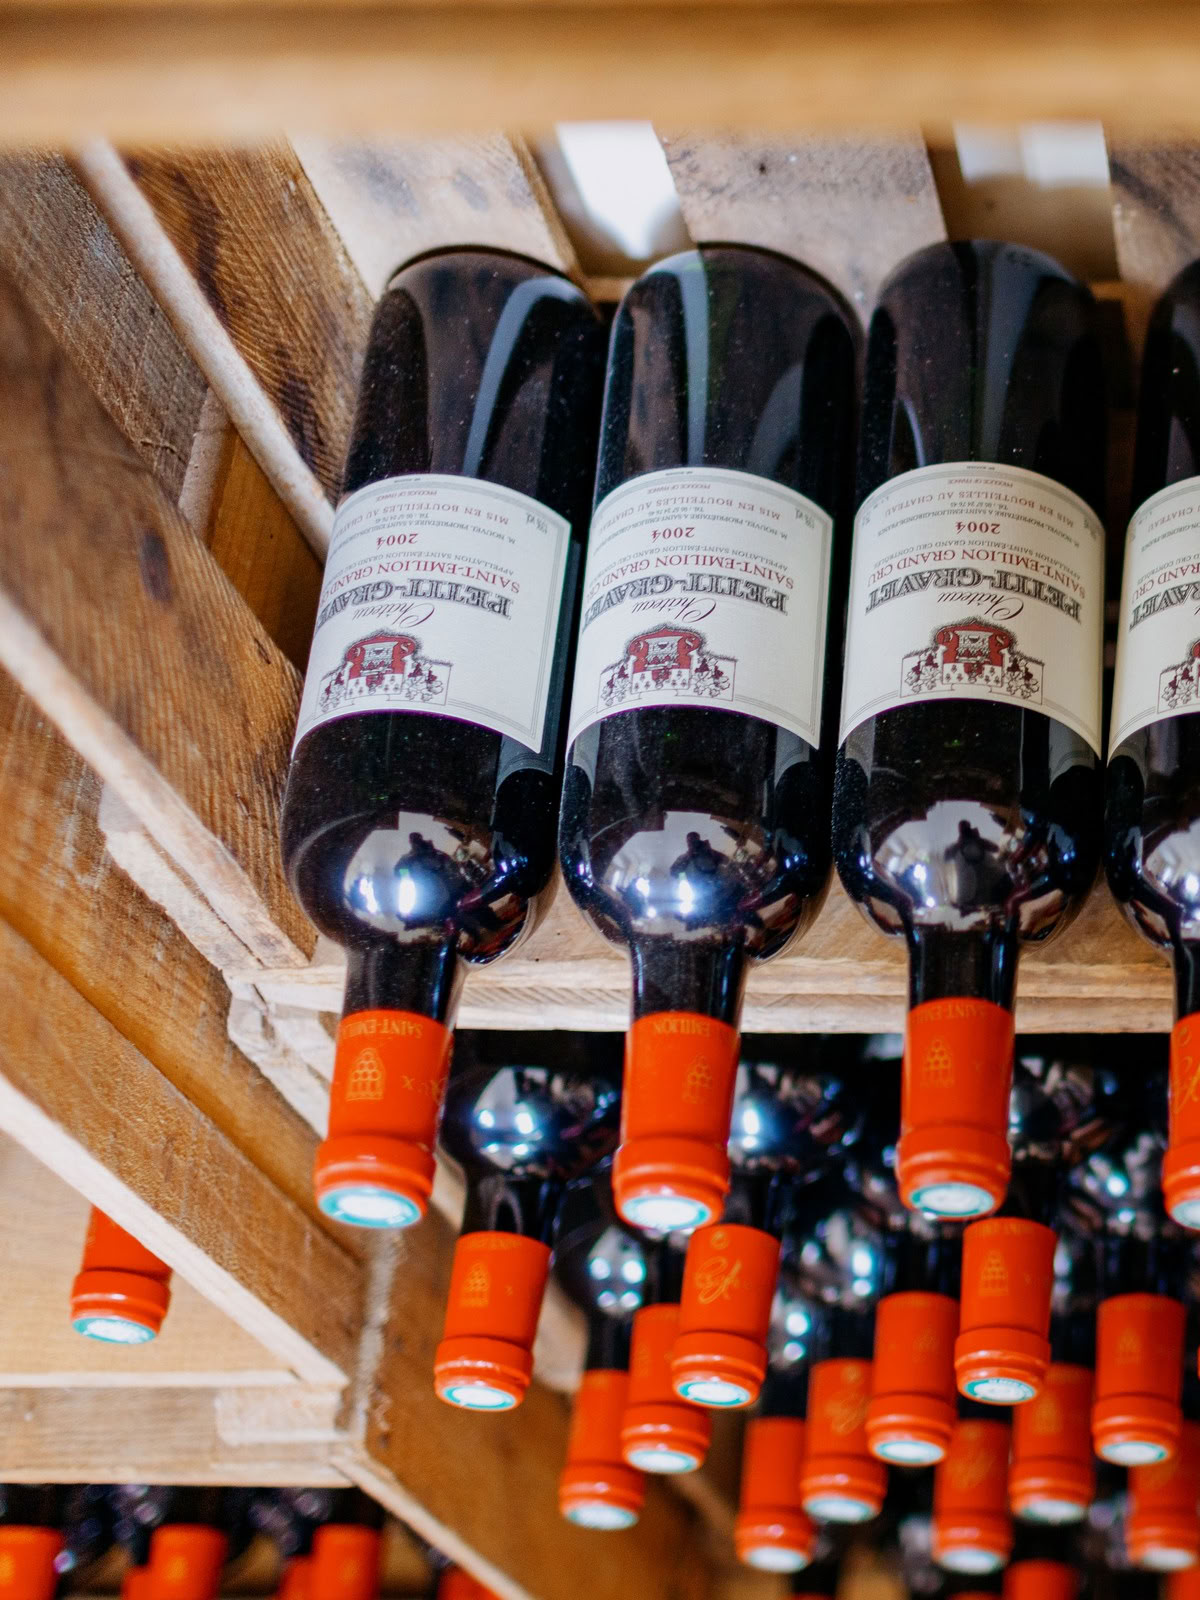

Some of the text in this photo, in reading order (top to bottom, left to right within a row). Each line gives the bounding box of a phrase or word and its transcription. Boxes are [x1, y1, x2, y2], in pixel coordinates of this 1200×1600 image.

[656, 497, 733, 508] BOUTEILLES
[938, 492, 954, 501] AU
[959, 491, 1036, 509] BOUTEILLES
[366, 508, 379, 518] AU
[383, 503, 460, 515] BOUTEILLES
[464, 507, 482, 517] EN
[637, 502, 652, 512] AU
[738, 501, 755, 512] EN
[884, 495, 934, 517] CHATEAU
[1039, 504, 1054, 516] EN
[486, 509, 509, 526] MIS
[758, 508, 781, 521] MIS
[1148, 507, 1194, 533] CHATEAU
[650, 527, 695, 543] 2004
[954, 520, 1001, 535] 2004
[376, 533, 419, 549] 2004
[915, 542, 933, 552] CRU
[934, 540, 966, 549] GRAND
[633, 548, 660, 558] GRAND
[731, 549, 788, 571] APPELLATION
[1175, 555, 1192, 566] CRU
[456, 555, 514, 577] APPELLATION
[602, 559, 650, 584] GRAND
[655, 555, 794, 589] SAINT-EMILION
[867, 549, 1085, 599] SAINT-EMILION GRAND CRU
[330, 566, 373, 594] GRAND
[378, 560, 520, 593] SAINT-EMILION
[865, 567, 1082, 626] PETIT-GRAVET
[1131, 579, 1154, 604] CRU
[631, 597, 717, 624] Château
[937, 591, 1024, 621] Château
[352, 602, 435, 628] Château
